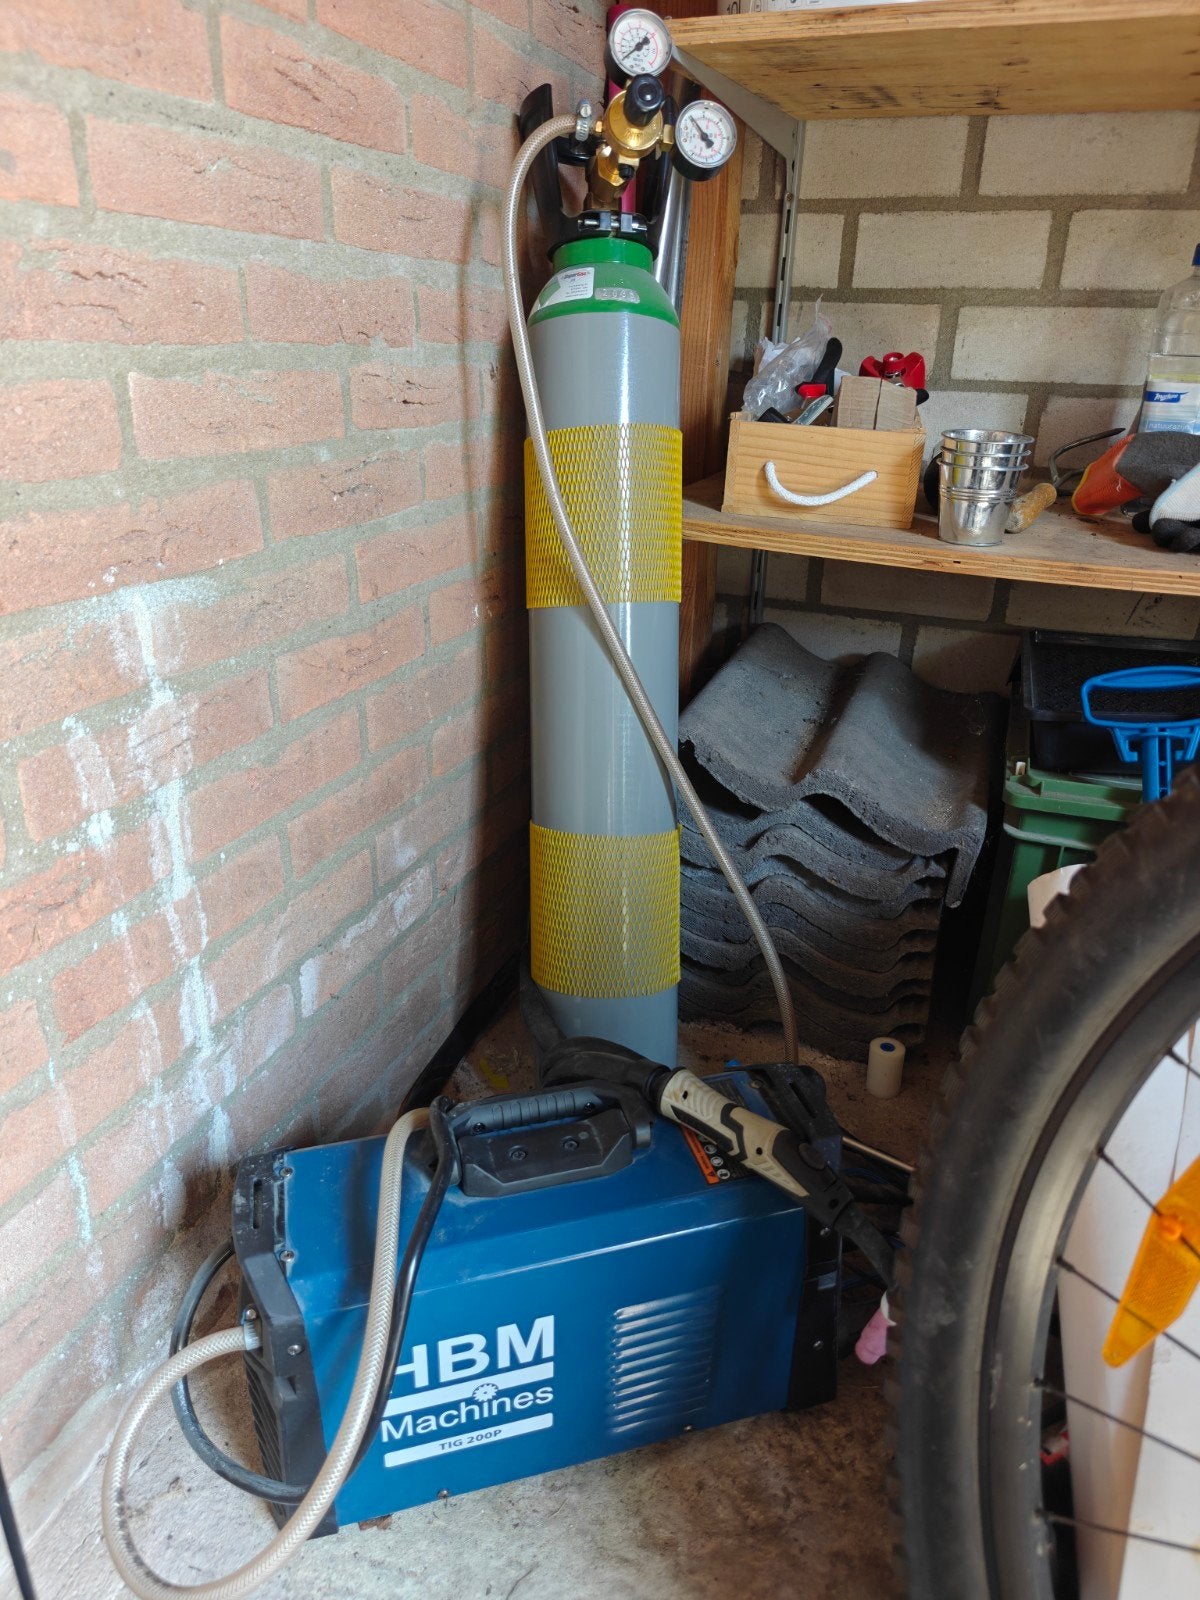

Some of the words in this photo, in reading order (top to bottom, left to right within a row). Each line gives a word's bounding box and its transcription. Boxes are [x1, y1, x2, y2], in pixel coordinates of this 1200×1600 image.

[395, 1315, 555, 1388] HBM
[381, 1386, 554, 1443] Machines
[439, 1439, 463, 1450] TIG
[466, 1429, 503, 1444] 200P
